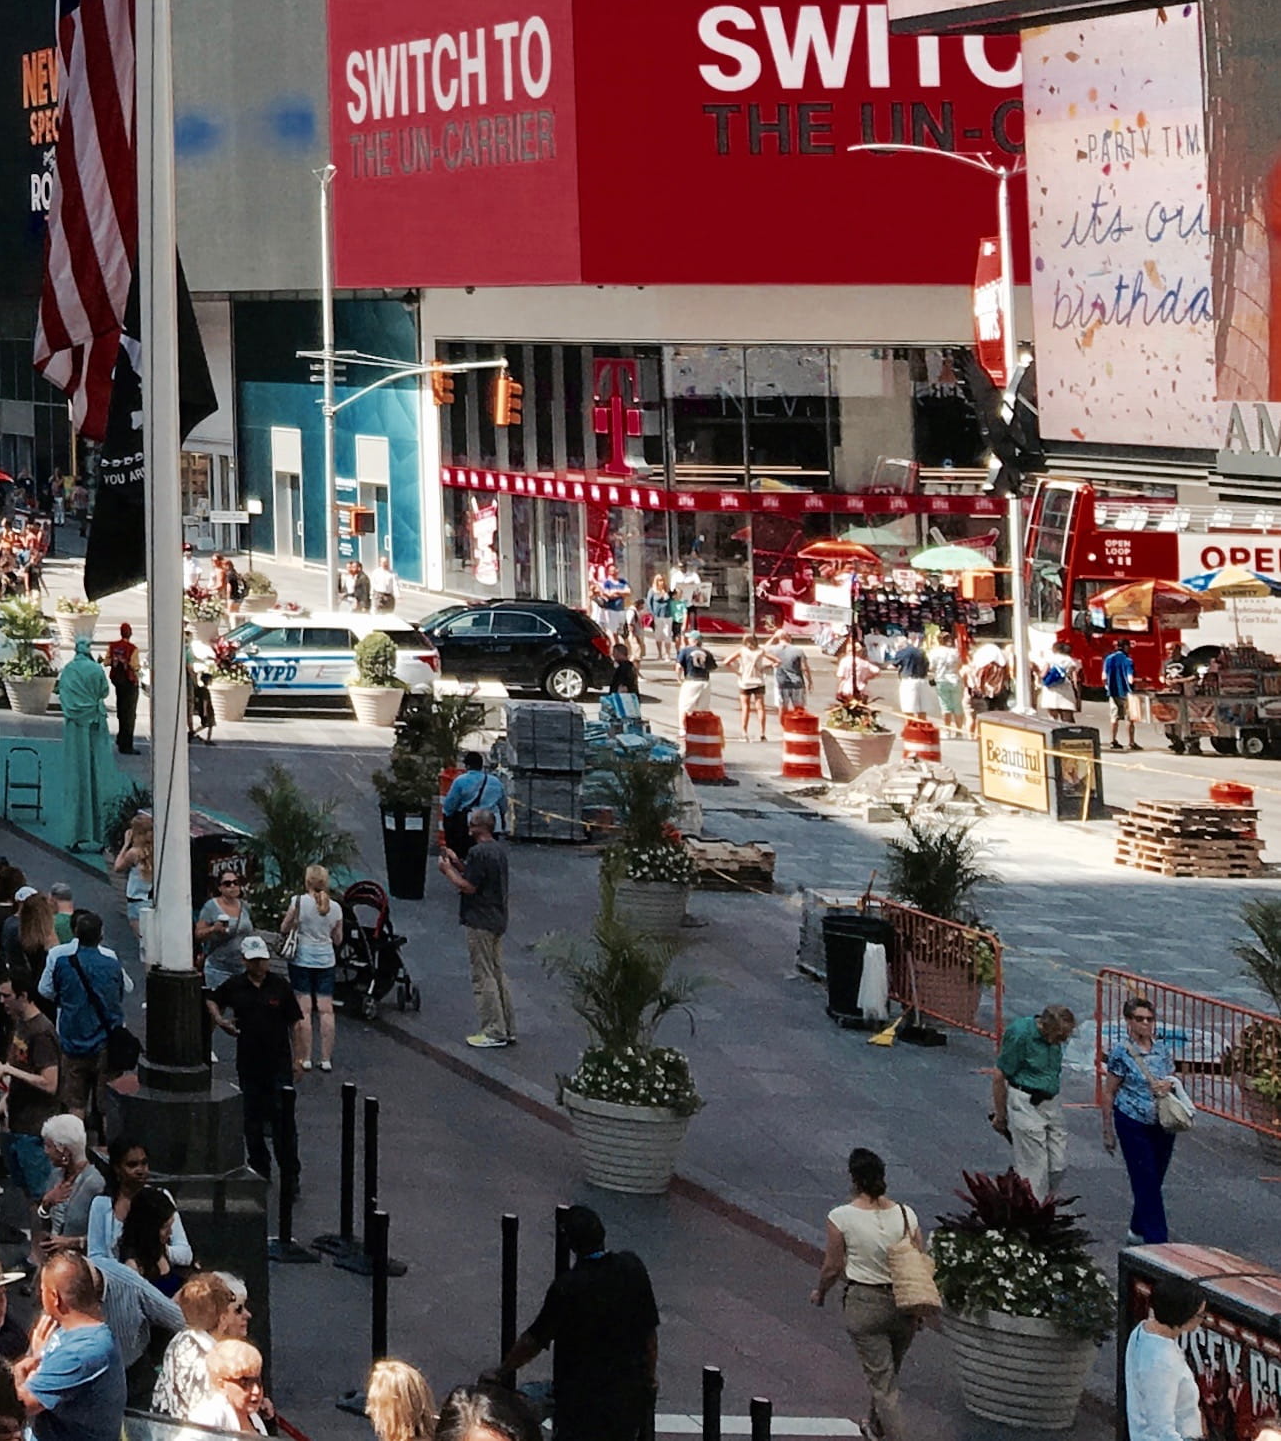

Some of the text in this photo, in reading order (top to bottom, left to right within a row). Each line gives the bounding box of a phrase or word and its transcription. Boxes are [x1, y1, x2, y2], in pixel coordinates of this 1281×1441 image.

[346, 14, 551, 125] SWITCH TO
[703, 102, 836, 157] THE
[1087, 127, 1152, 161] PARTY
[103, 473, 126, 485] YOU
[1104, 539, 1131, 548] OPEN
[1105, 547, 1131, 555] LOOP
[249, 664, 297, 683] NYPD
[986, 739, 1041, 772] Beautiful
